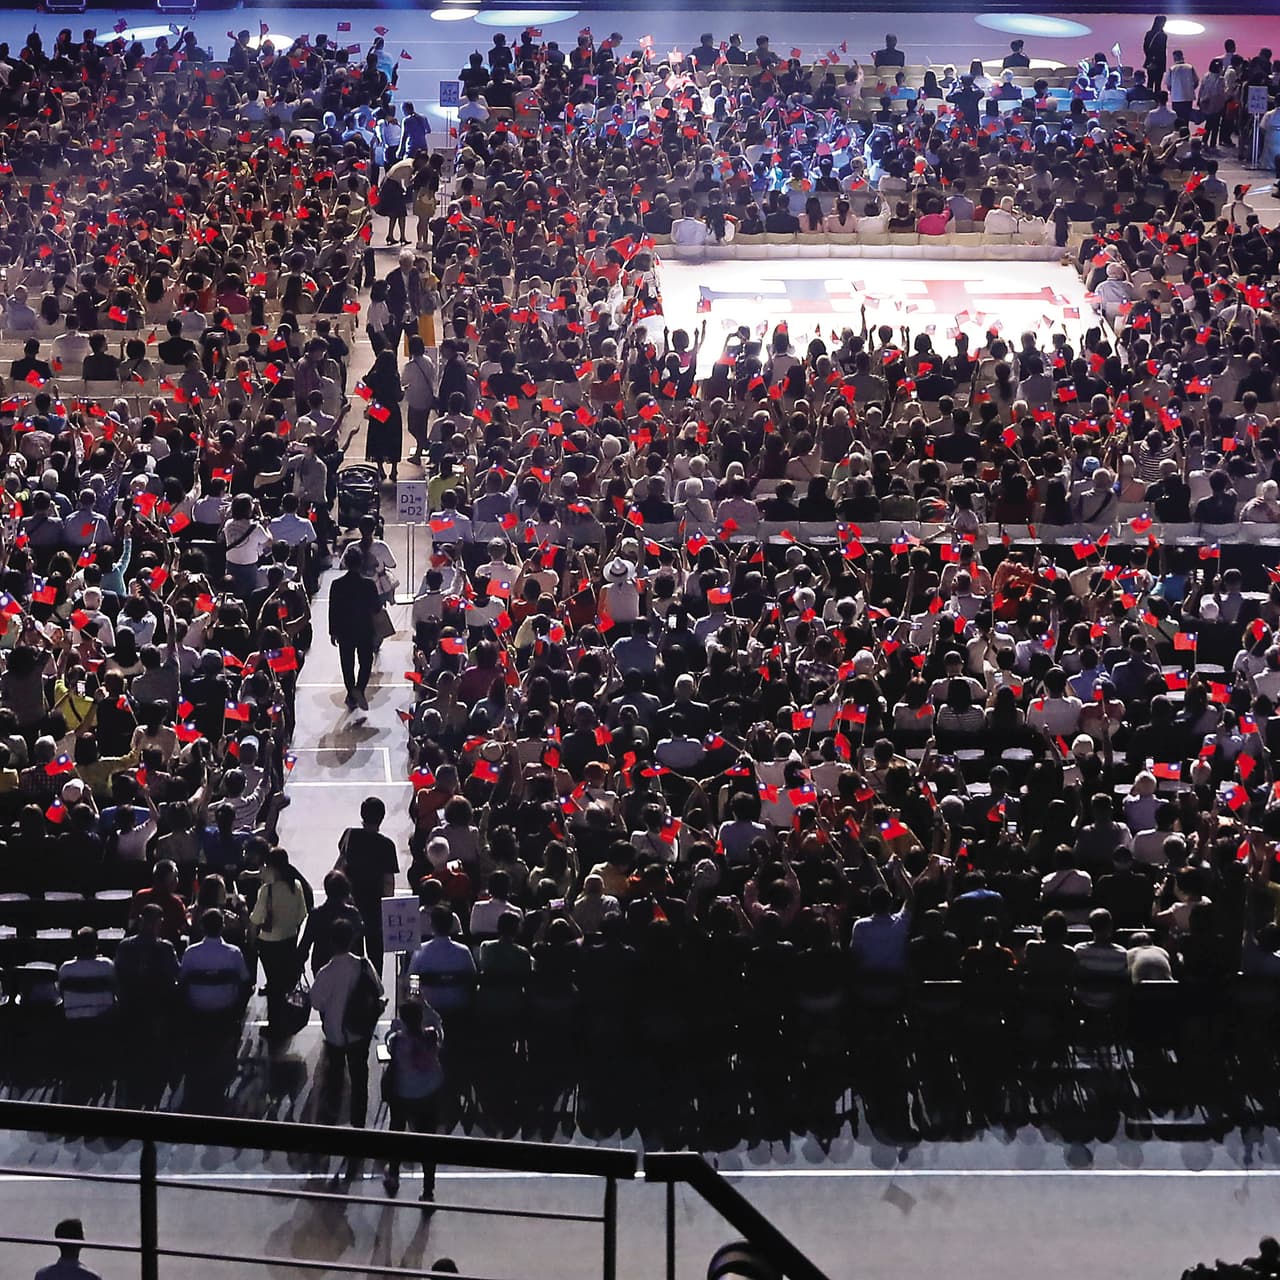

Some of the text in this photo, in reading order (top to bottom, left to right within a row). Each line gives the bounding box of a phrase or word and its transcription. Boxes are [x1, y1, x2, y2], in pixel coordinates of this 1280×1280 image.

[401, 494, 415, 504] D1
[407, 506, 422, 516] D2
[389, 915, 402, 927] E1
[399, 930, 413, 942] E2
